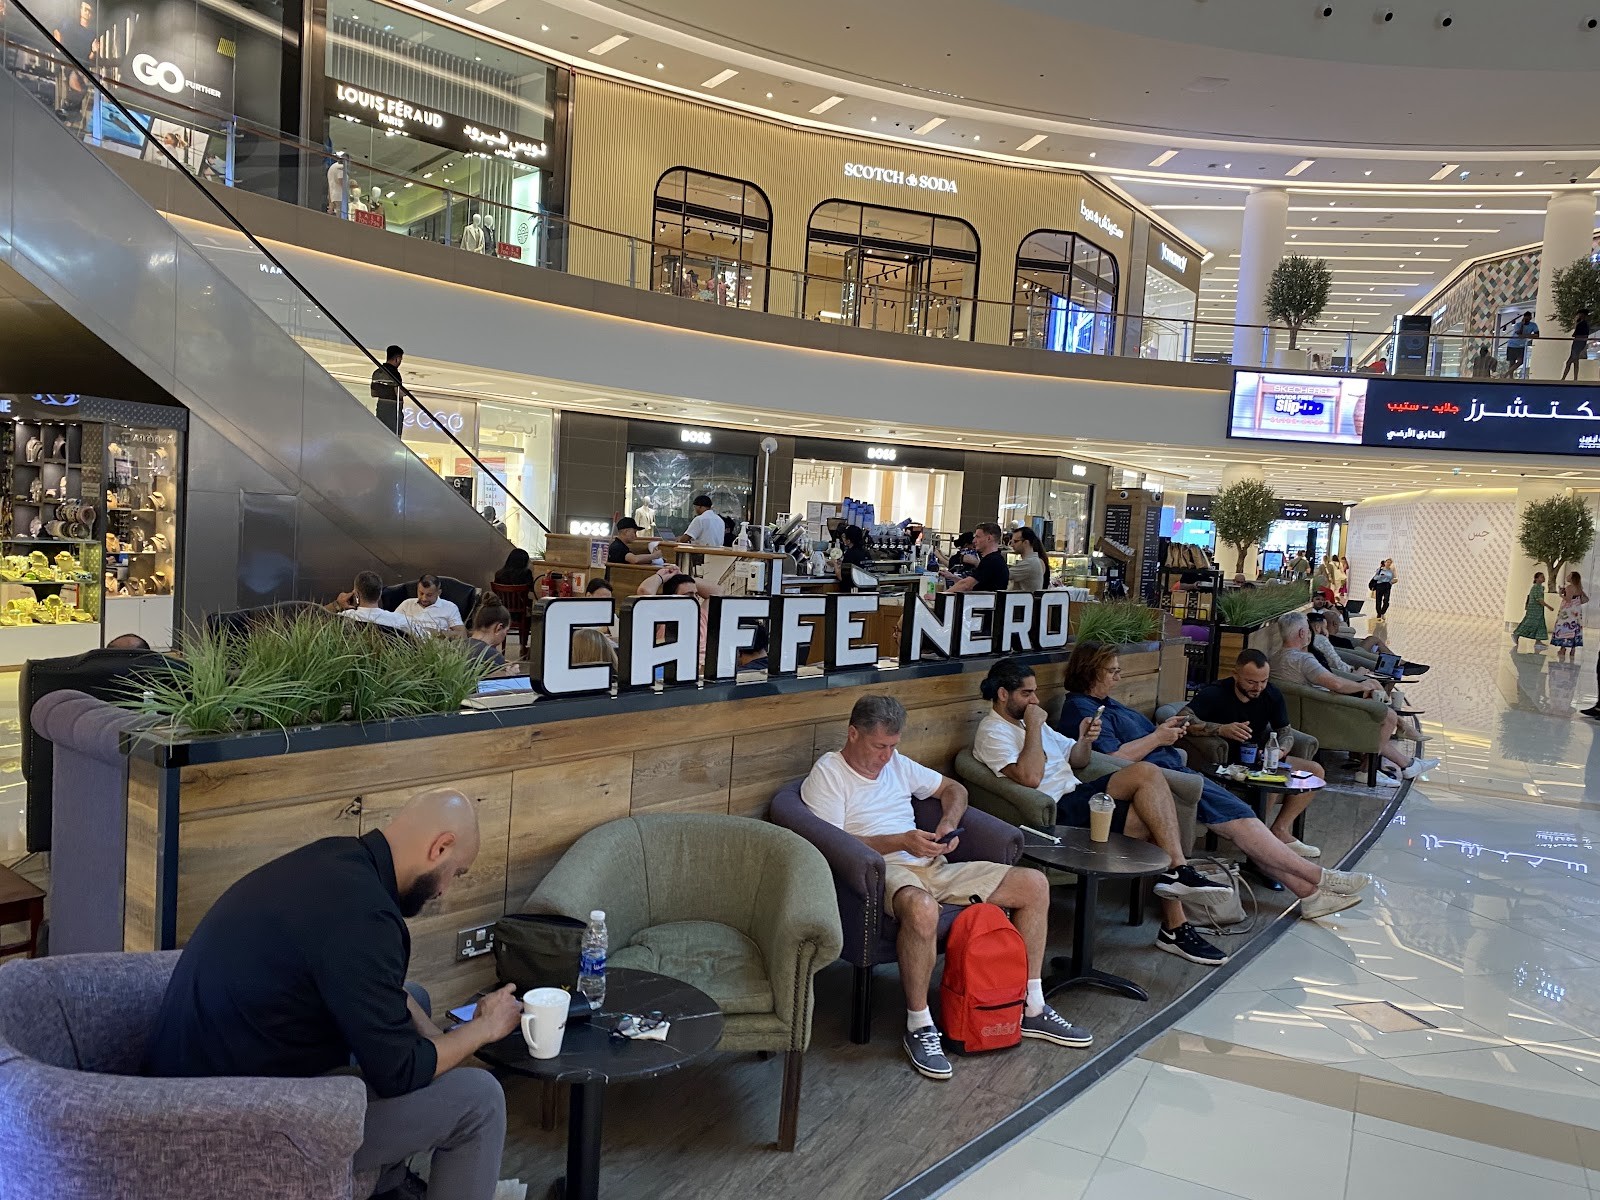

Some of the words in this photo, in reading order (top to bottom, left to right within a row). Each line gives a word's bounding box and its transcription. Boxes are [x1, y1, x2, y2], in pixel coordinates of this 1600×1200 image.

[132, 53, 185, 94] GO
[185, 79, 222, 98] FURTHER
[337, 83, 385, 112] LOUIS
[387, 99, 444, 128] FÉRAUD
[844, 162, 905, 185] SCOTCH
[905, 173, 919, 187] &
[918, 175, 959, 194] SODA
[1273, 385, 1329, 394] SKECHERS
[1386, 401, 1420, 412] ستيب
[1431, 401, 1460, 414] جلايد
[681, 429, 712, 444] BOSS
[1386, 428, 1416, 440] الأرضي
[1416, 430, 1446, 440] الطابق
[867, 447, 897, 461] BOSS
[569, 521, 610, 537] BOSS
[903, 590, 1071, 662] NERO
